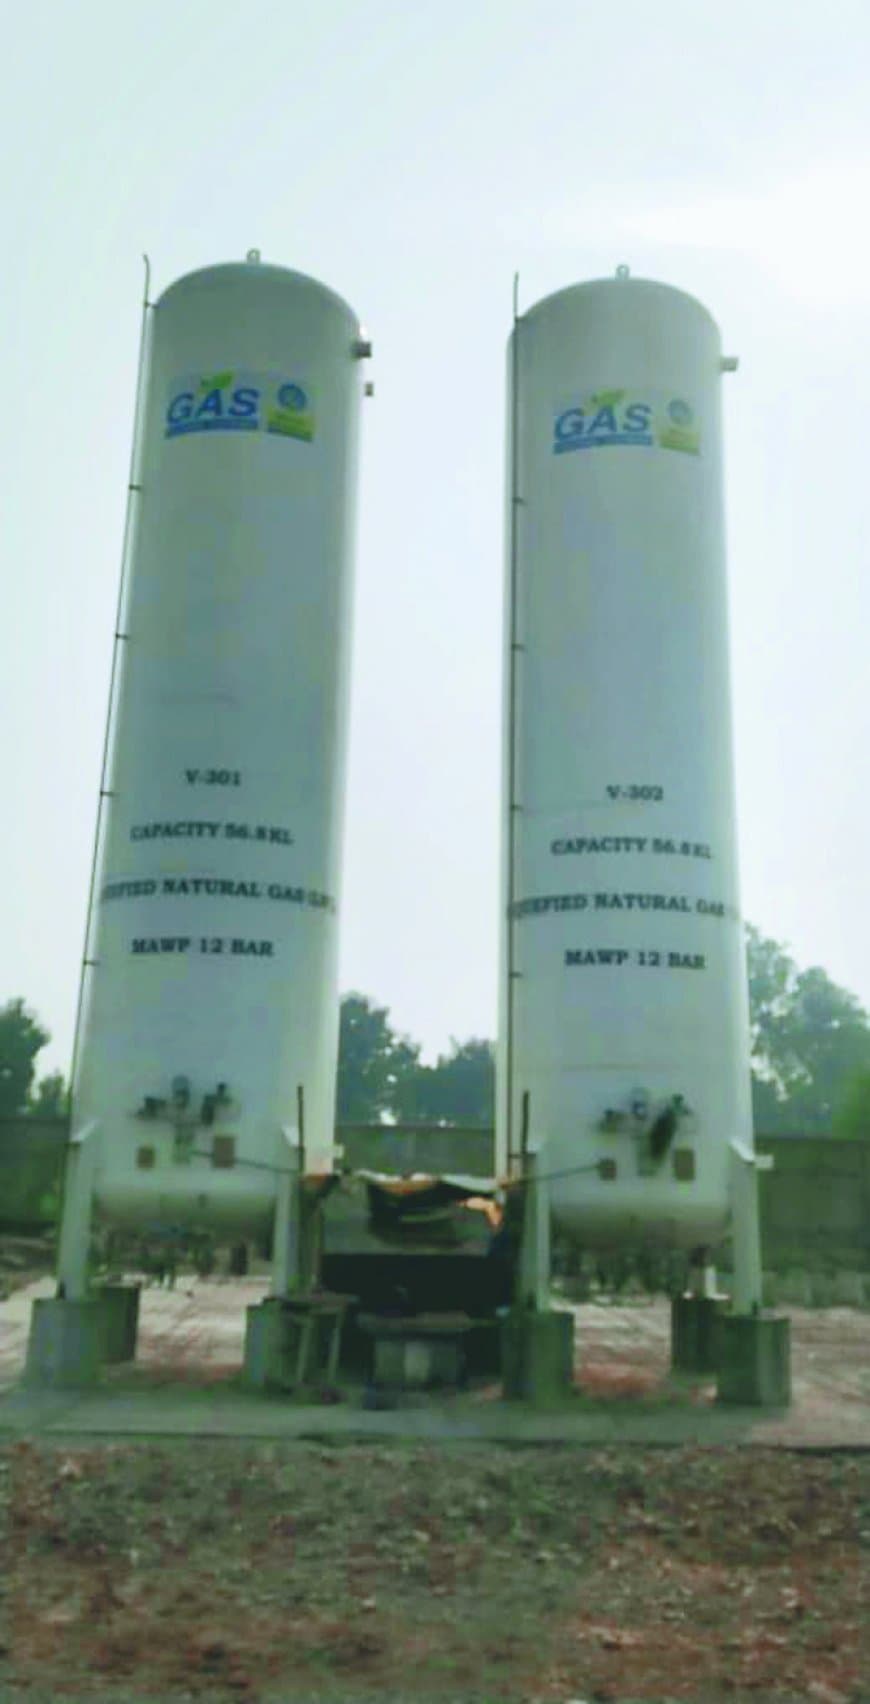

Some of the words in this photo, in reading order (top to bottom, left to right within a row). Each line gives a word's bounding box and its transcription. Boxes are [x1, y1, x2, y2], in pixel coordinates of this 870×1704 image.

[166, 387, 260, 425] GAS
[554, 402, 652, 438] GAS
[184, 768, 242, 786] V-301
[606, 785, 664, 801] V-302
[129, 821, 221, 843] CAPACITY
[550, 836, 648, 856] CAPACITY
[162, 877, 262, 898] NATURAL
[267, 883, 305, 904] GAS
[594, 892, 691, 914] NATURAL
[131, 937, 192, 955] MAWP
[200, 938, 223, 955] 12
[231, 939, 274, 957] BAR
[564, 950, 630, 967] MAWP
[637, 951, 661, 967] 12
[667, 952, 706, 970] BAR
